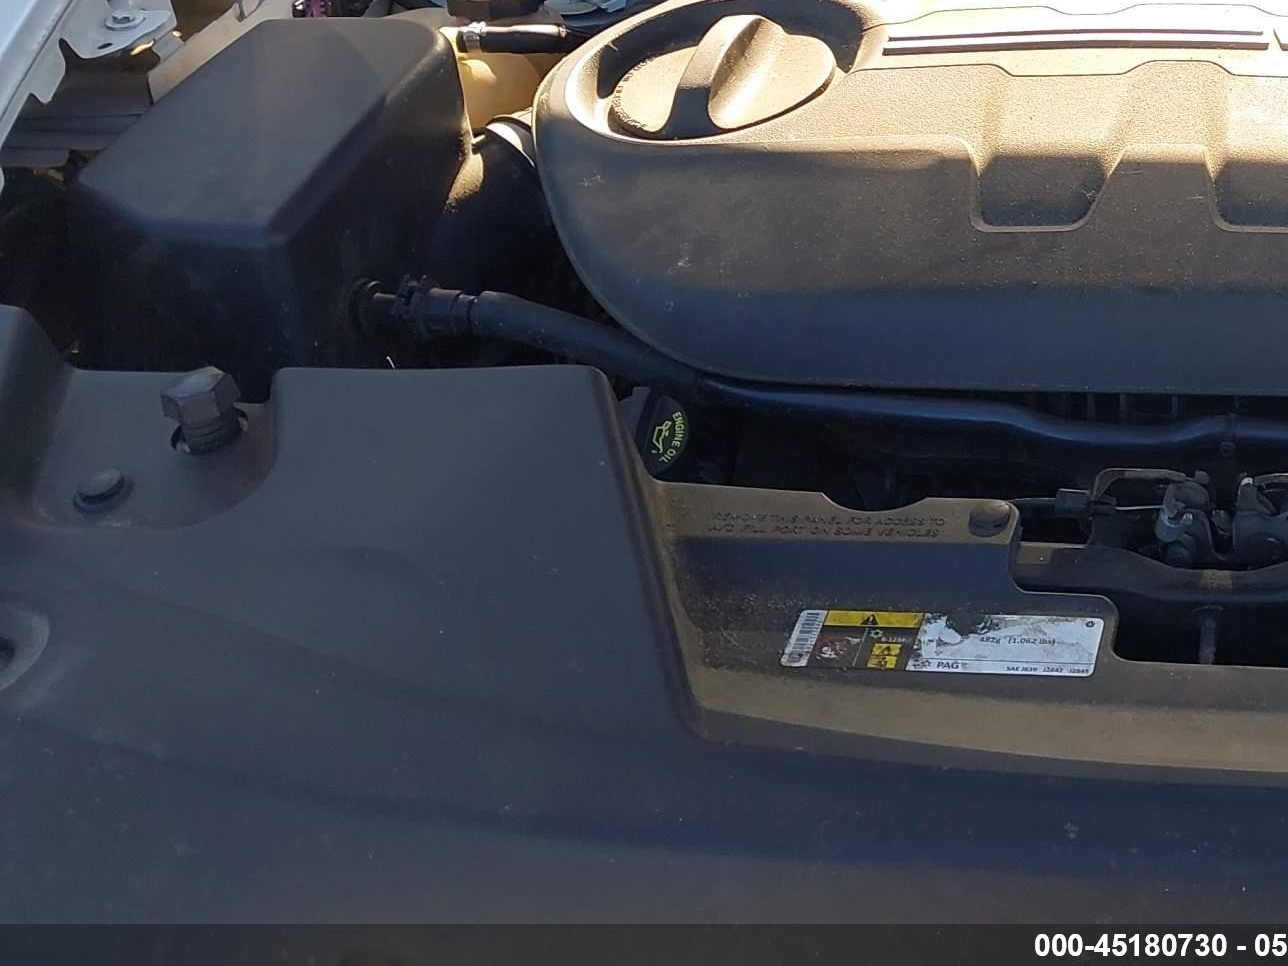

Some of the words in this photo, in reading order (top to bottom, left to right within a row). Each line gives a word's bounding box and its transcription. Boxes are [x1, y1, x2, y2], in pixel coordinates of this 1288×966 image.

[672, 411, 685, 448] ENGINE
[659, 448, 677, 463] OIL
[849, 516, 874, 526] FOR
[929, 517, 946, 527] TO
[979, 636, 1001, 645] 482g
[1008, 637, 1037, 646] (1.062
[937, 661, 960, 670] PAG
